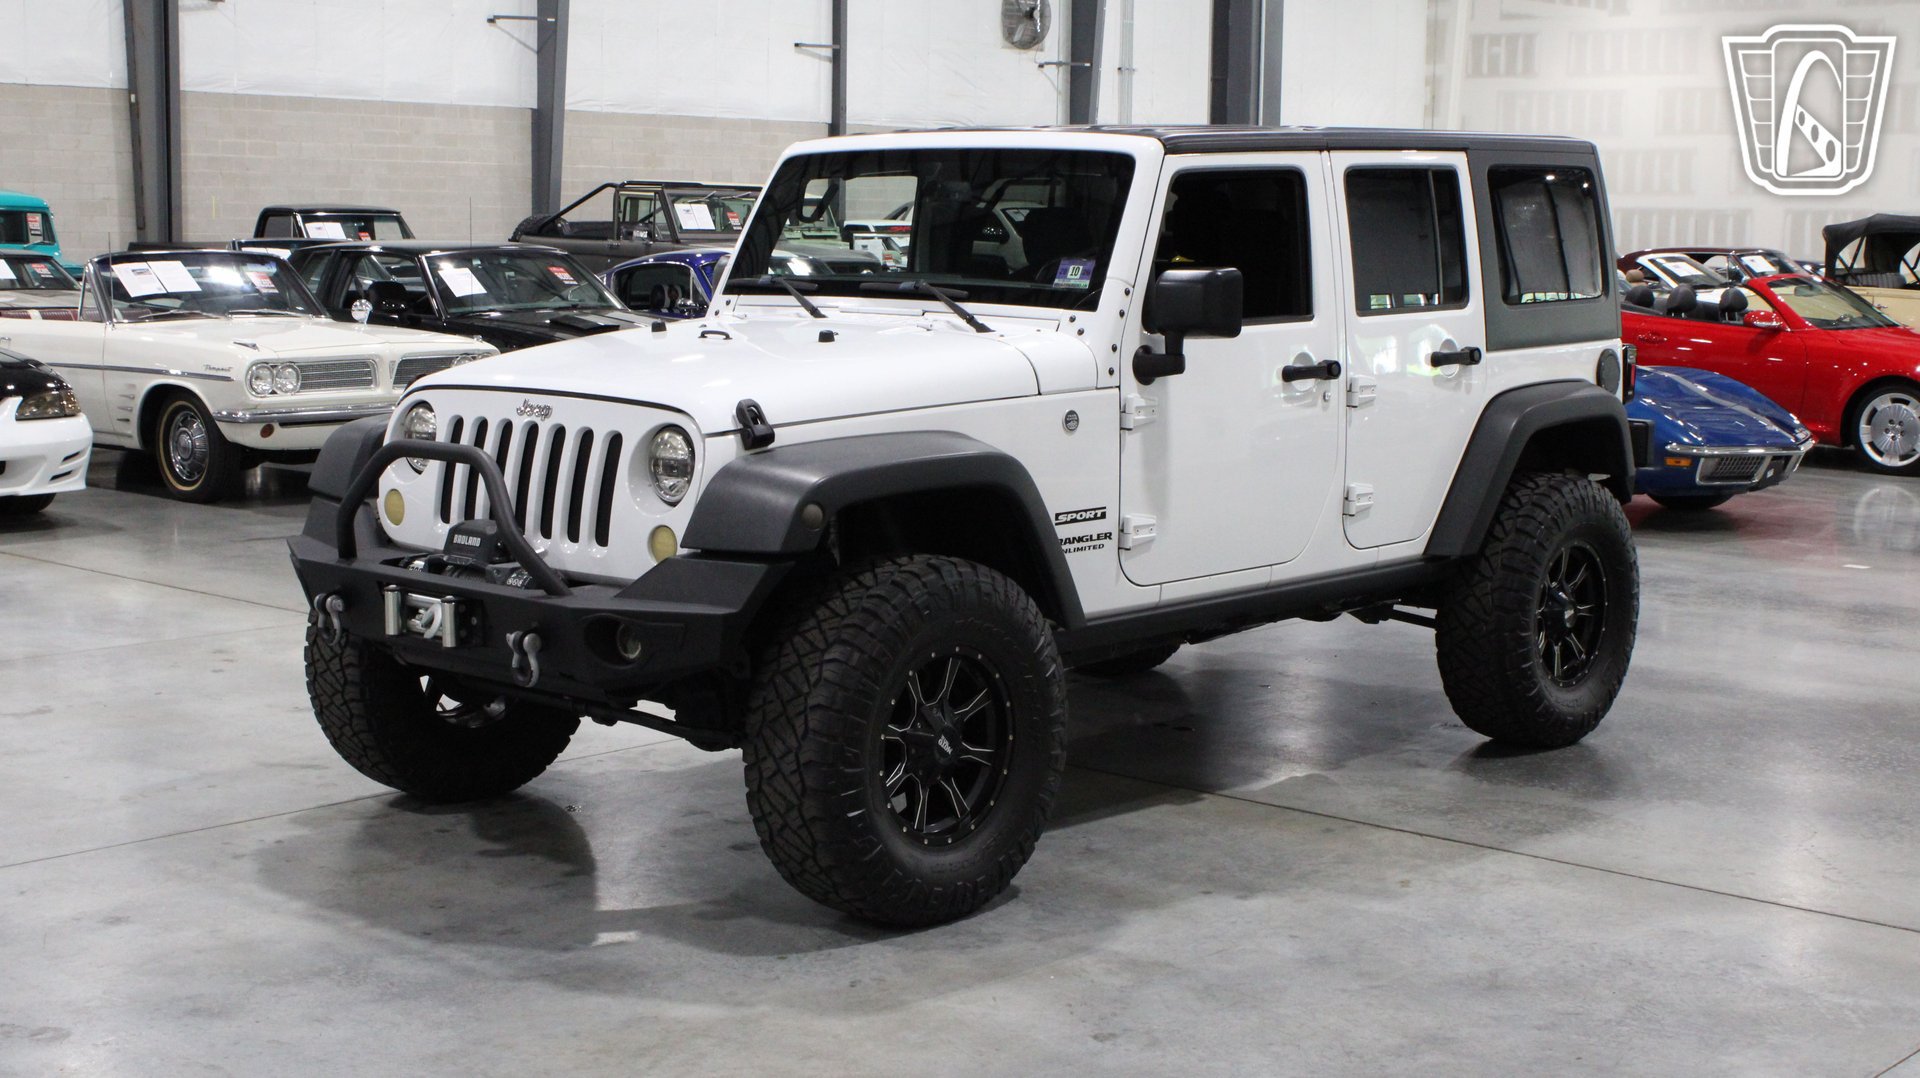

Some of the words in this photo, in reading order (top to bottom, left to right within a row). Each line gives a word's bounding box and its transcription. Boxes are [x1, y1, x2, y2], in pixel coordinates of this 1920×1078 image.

[1070, 266, 1081, 277] 10
[516, 398, 553, 421] Jeep
[1055, 508, 1106, 524] SPORT
[453, 534, 481, 547] BADLAND
[1059, 532, 1112, 546] RANGLER
[1062, 543, 1104, 554] NLIMITED
